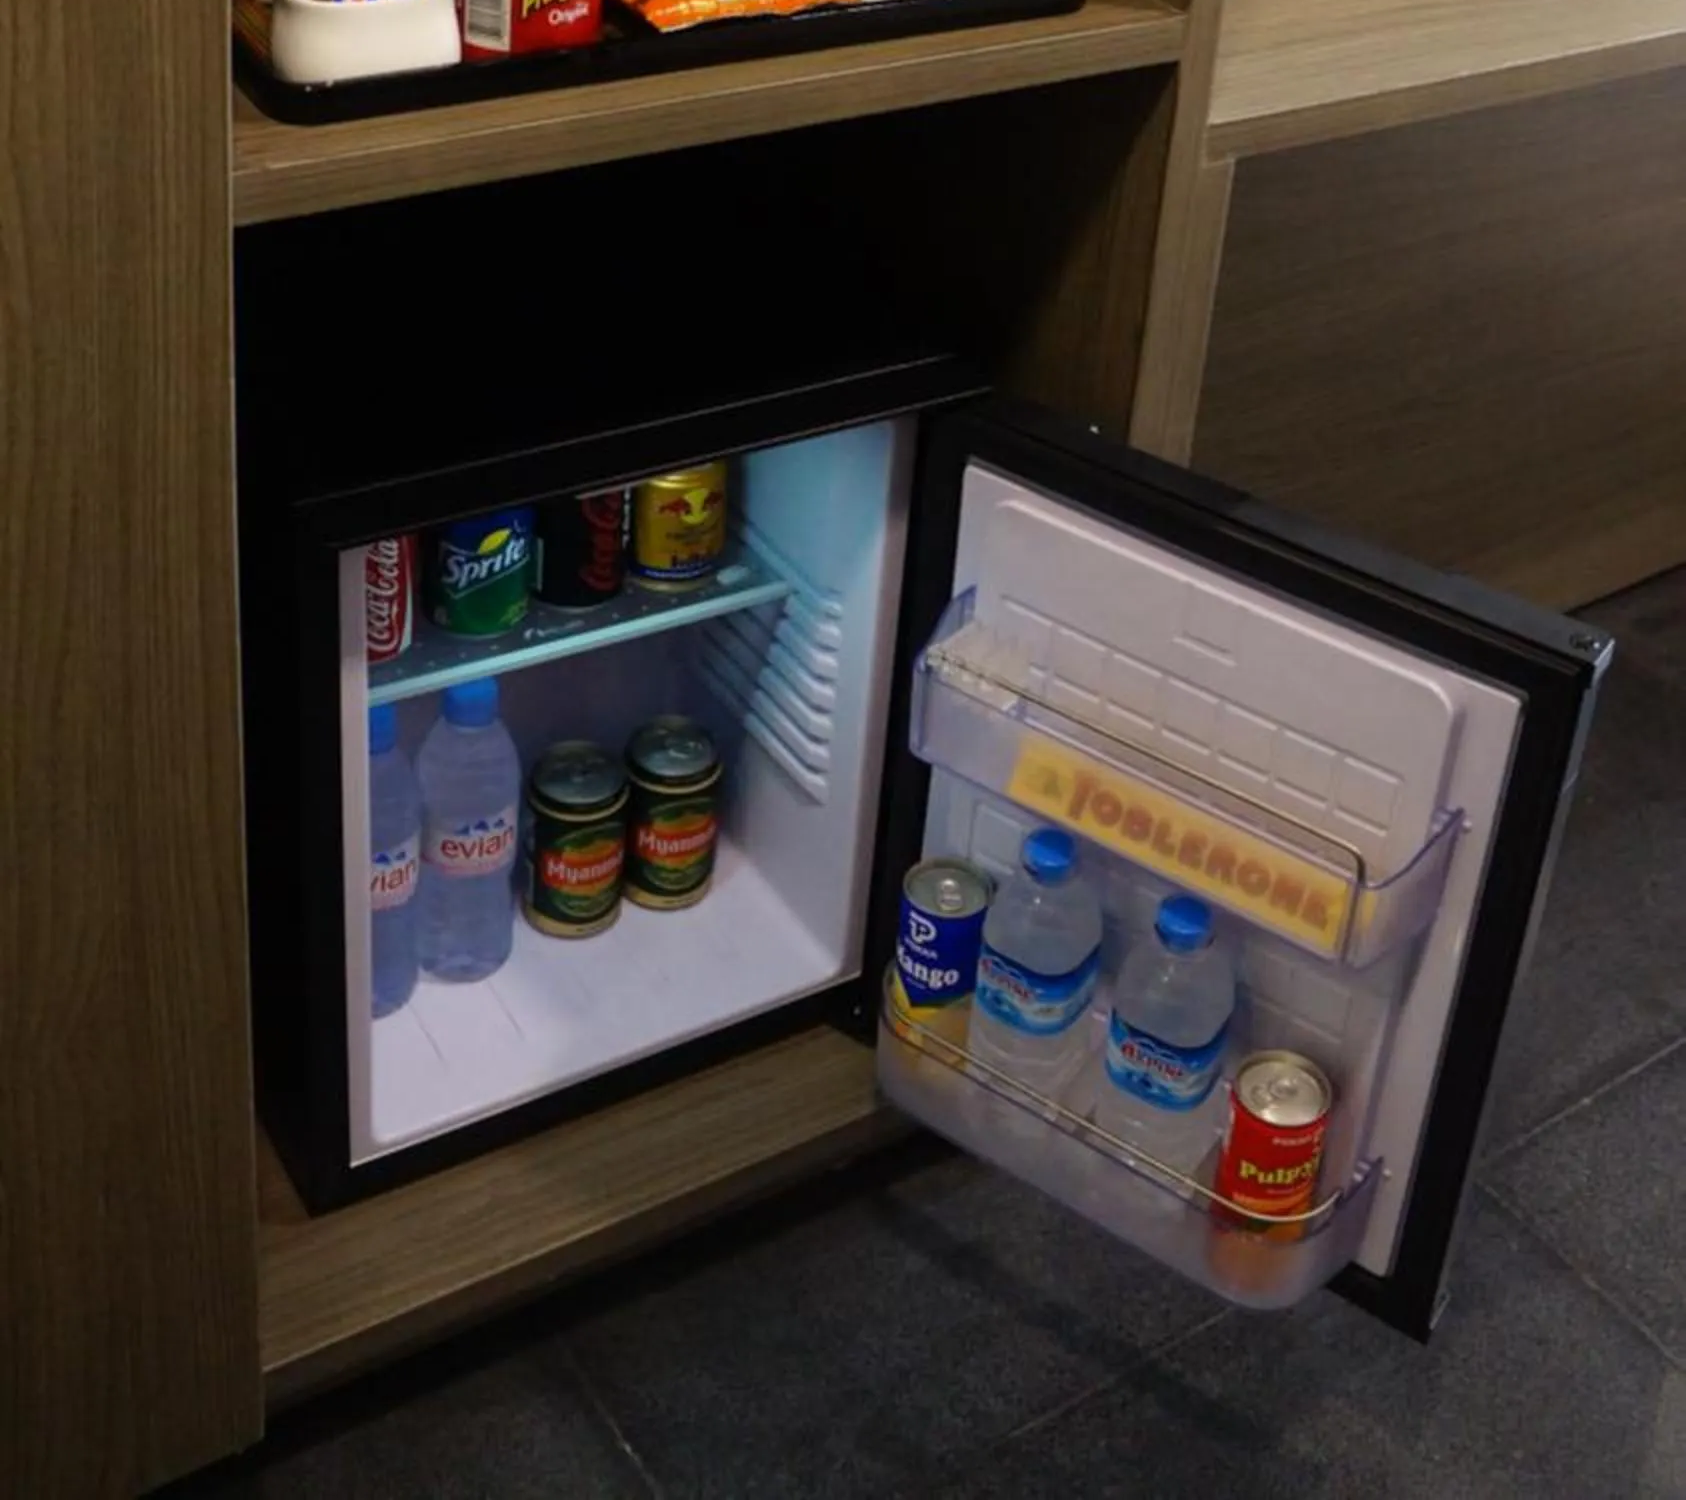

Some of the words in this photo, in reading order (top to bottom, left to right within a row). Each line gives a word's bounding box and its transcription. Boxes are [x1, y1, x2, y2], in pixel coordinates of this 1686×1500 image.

[442, 536, 526, 589] Sprite
[440, 826, 514, 859] evian
[1067, 768, 1329, 931] TOBLERONE
